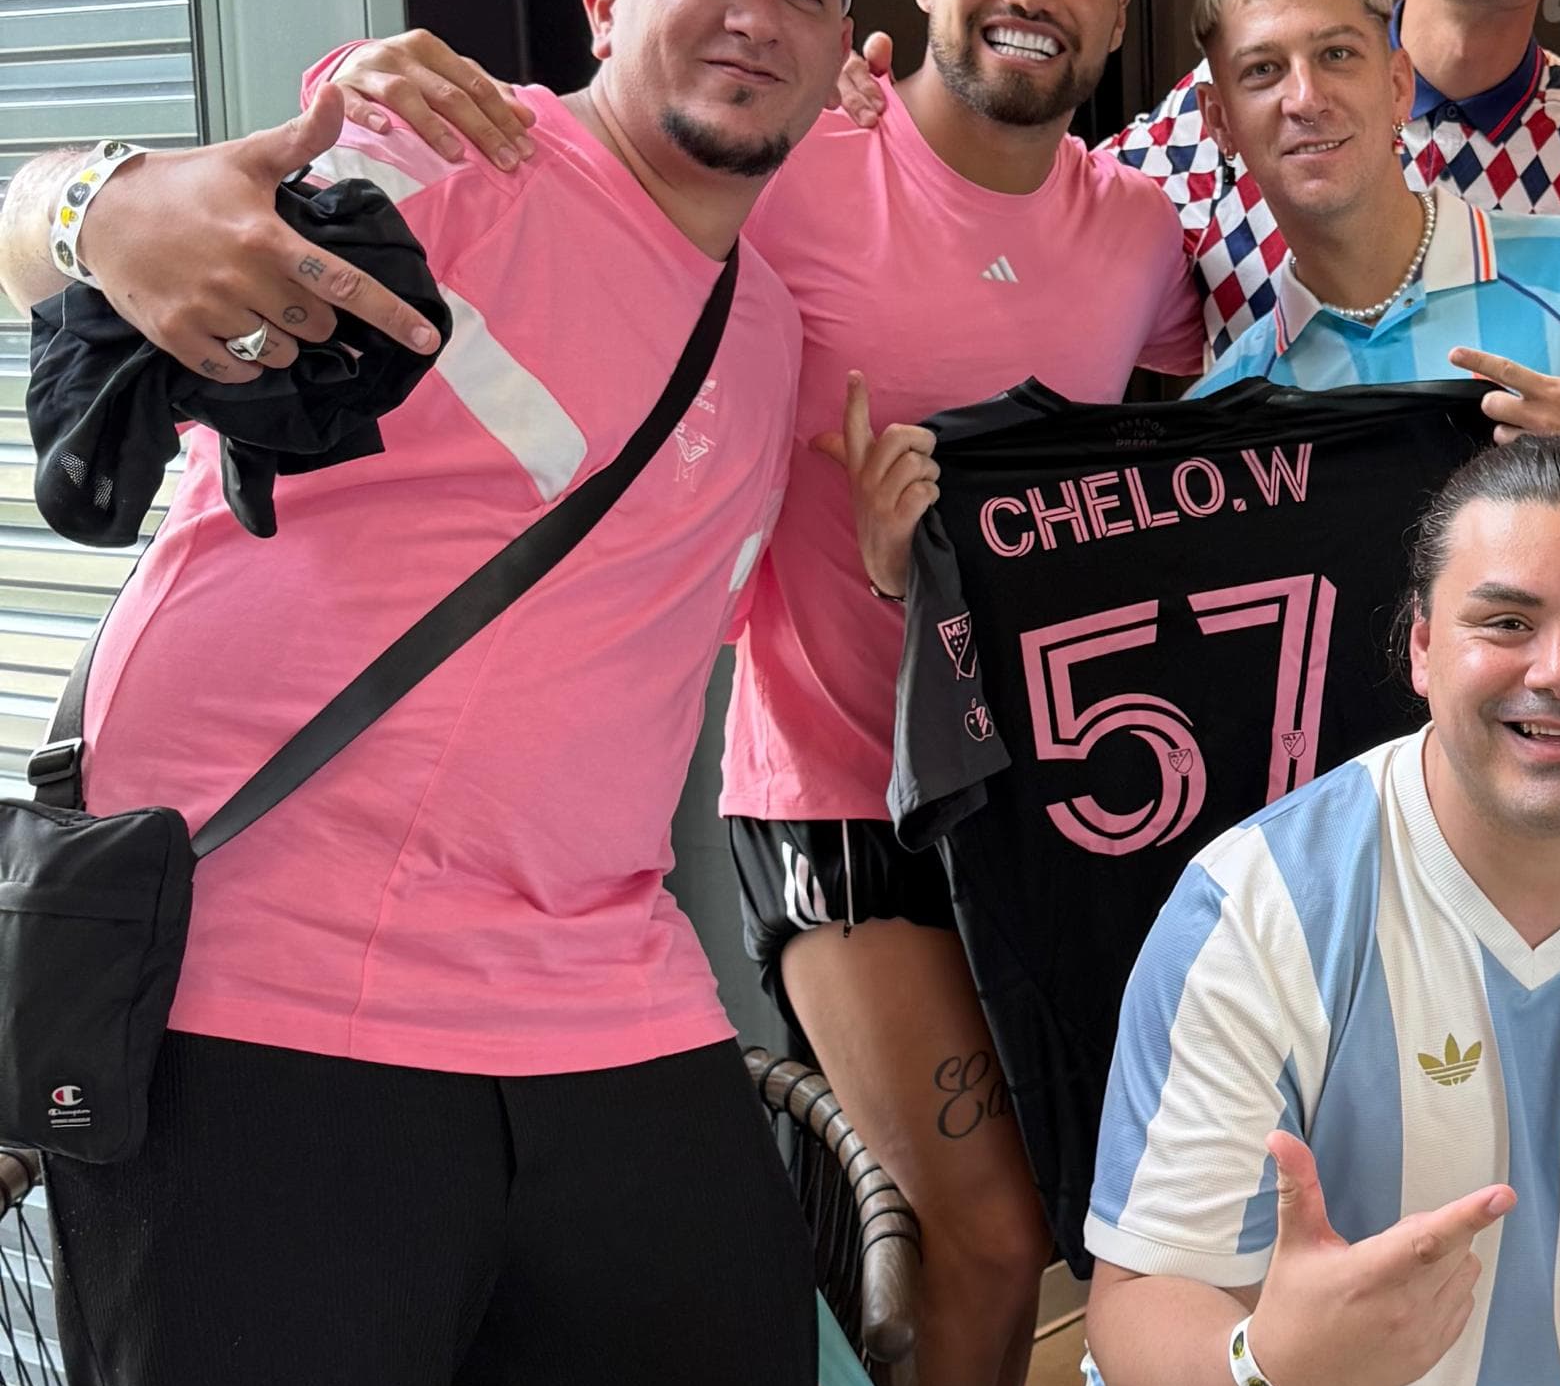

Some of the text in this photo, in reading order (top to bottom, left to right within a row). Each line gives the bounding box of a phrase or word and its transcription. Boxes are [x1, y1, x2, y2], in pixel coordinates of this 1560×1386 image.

[979, 443, 1313, 558] CHELO.W
[944, 619, 969, 640] MLS
[1019, 573, 1338, 856] 57
